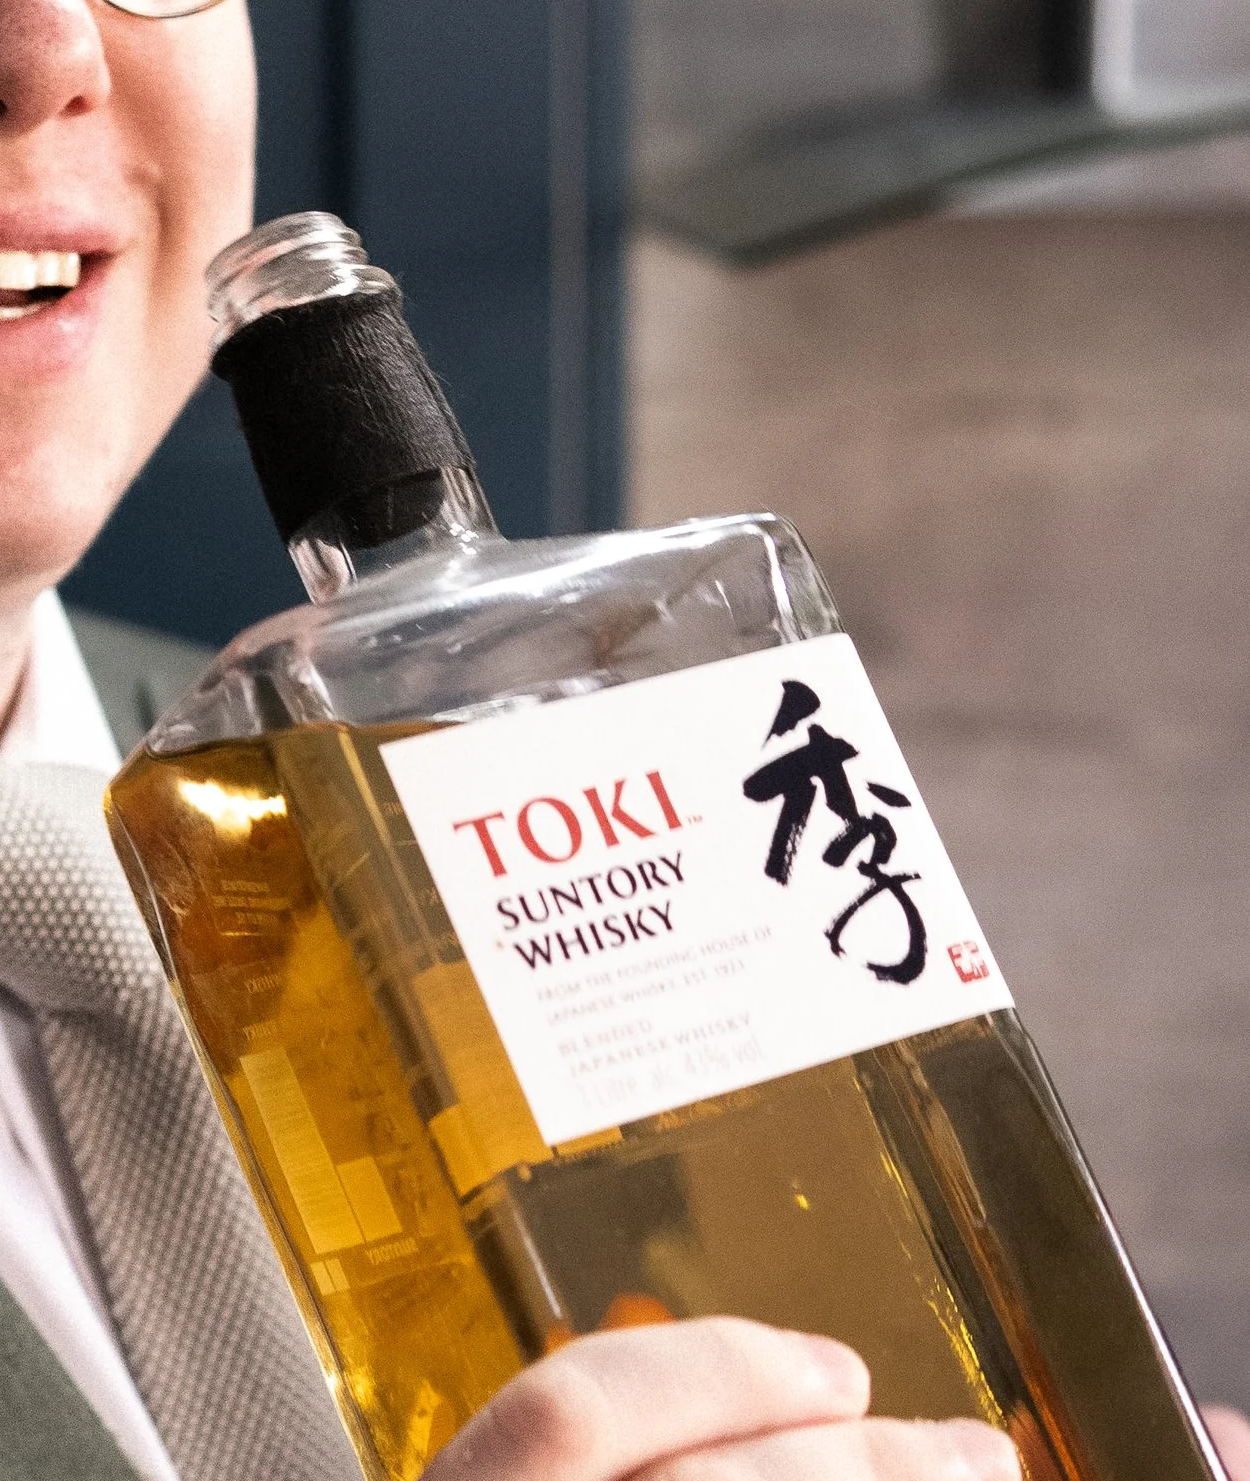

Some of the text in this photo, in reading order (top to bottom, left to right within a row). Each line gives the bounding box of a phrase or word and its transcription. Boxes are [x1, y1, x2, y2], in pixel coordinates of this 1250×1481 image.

[453, 770, 682, 878] TOKI
[496, 851, 685, 931] SUNTORY
[513, 900, 674, 970] WHISKY
[558, 1019, 654, 1058] BLENDED
[570, 1012, 752, 1079] JAPANESE WHISKY
